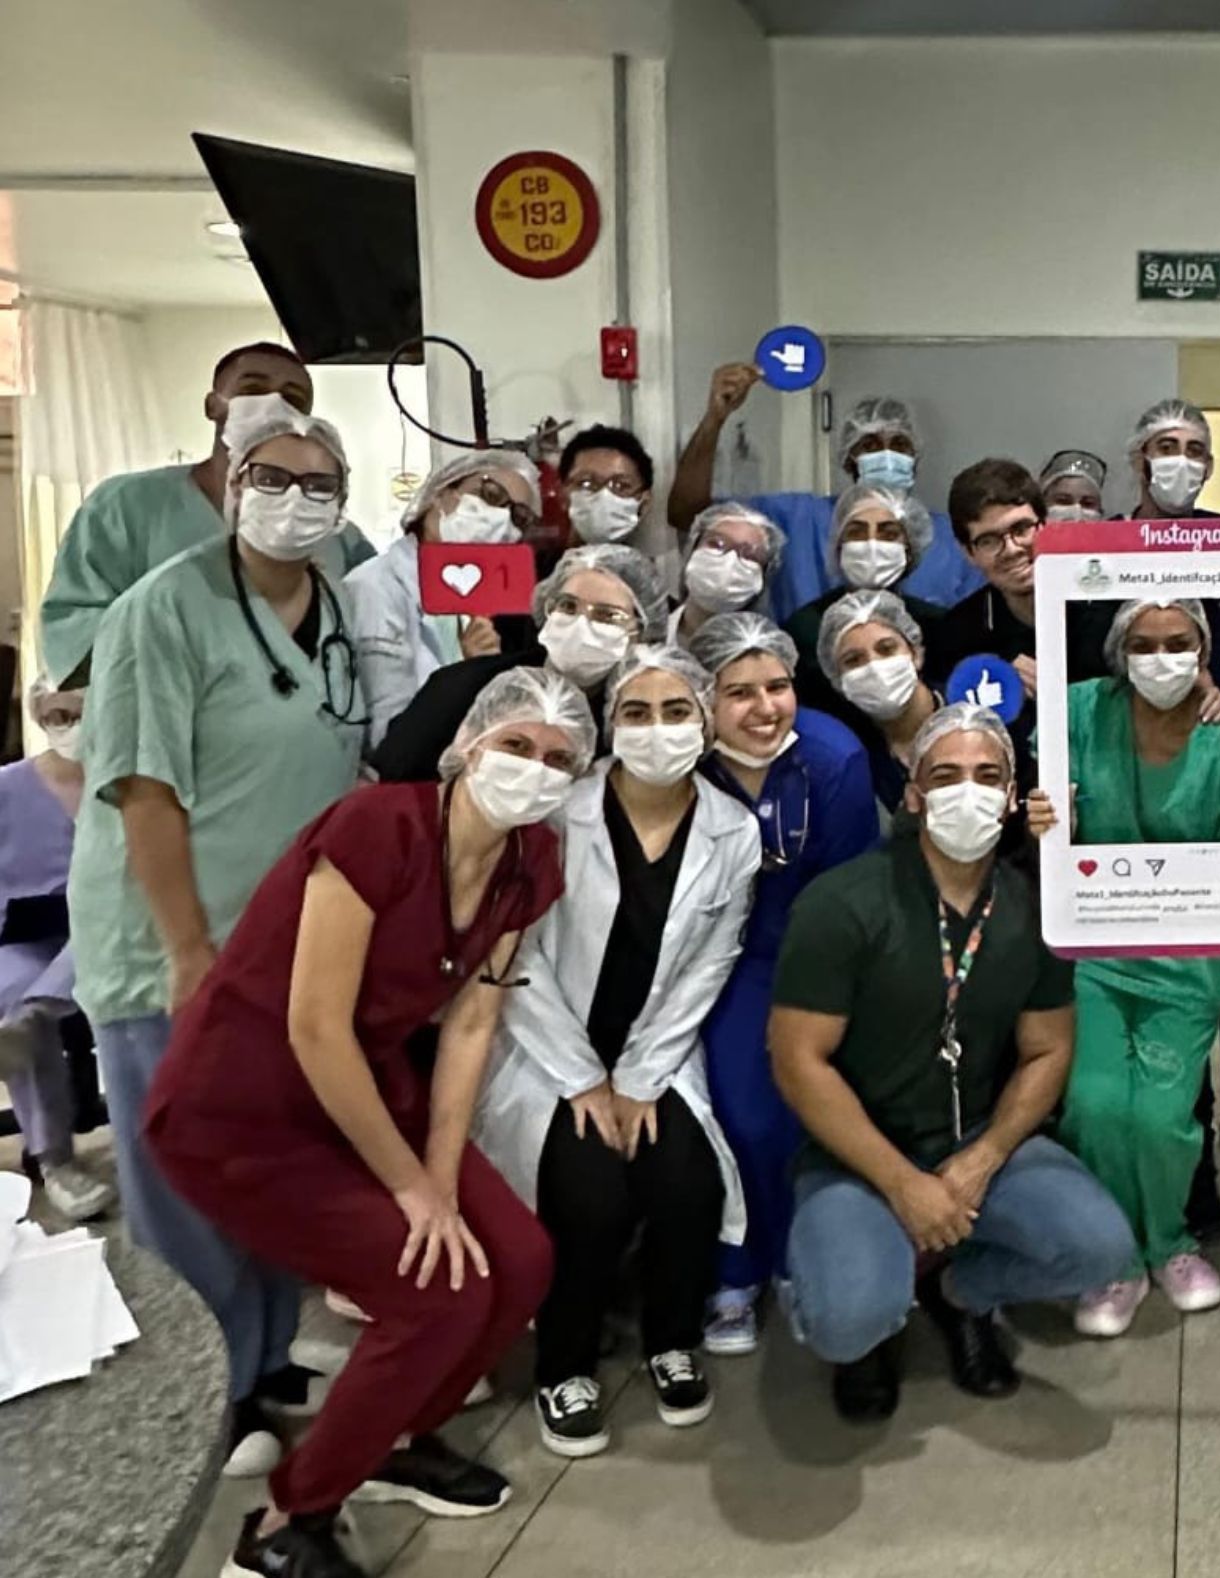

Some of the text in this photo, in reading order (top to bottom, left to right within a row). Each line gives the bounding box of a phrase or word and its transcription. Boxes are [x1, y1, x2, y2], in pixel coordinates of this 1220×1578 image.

[521, 176, 549, 195] CB
[521, 201, 566, 226] 193
[1145, 259, 1215, 281] SAÍDA
[497, 563, 509, 591] 1
